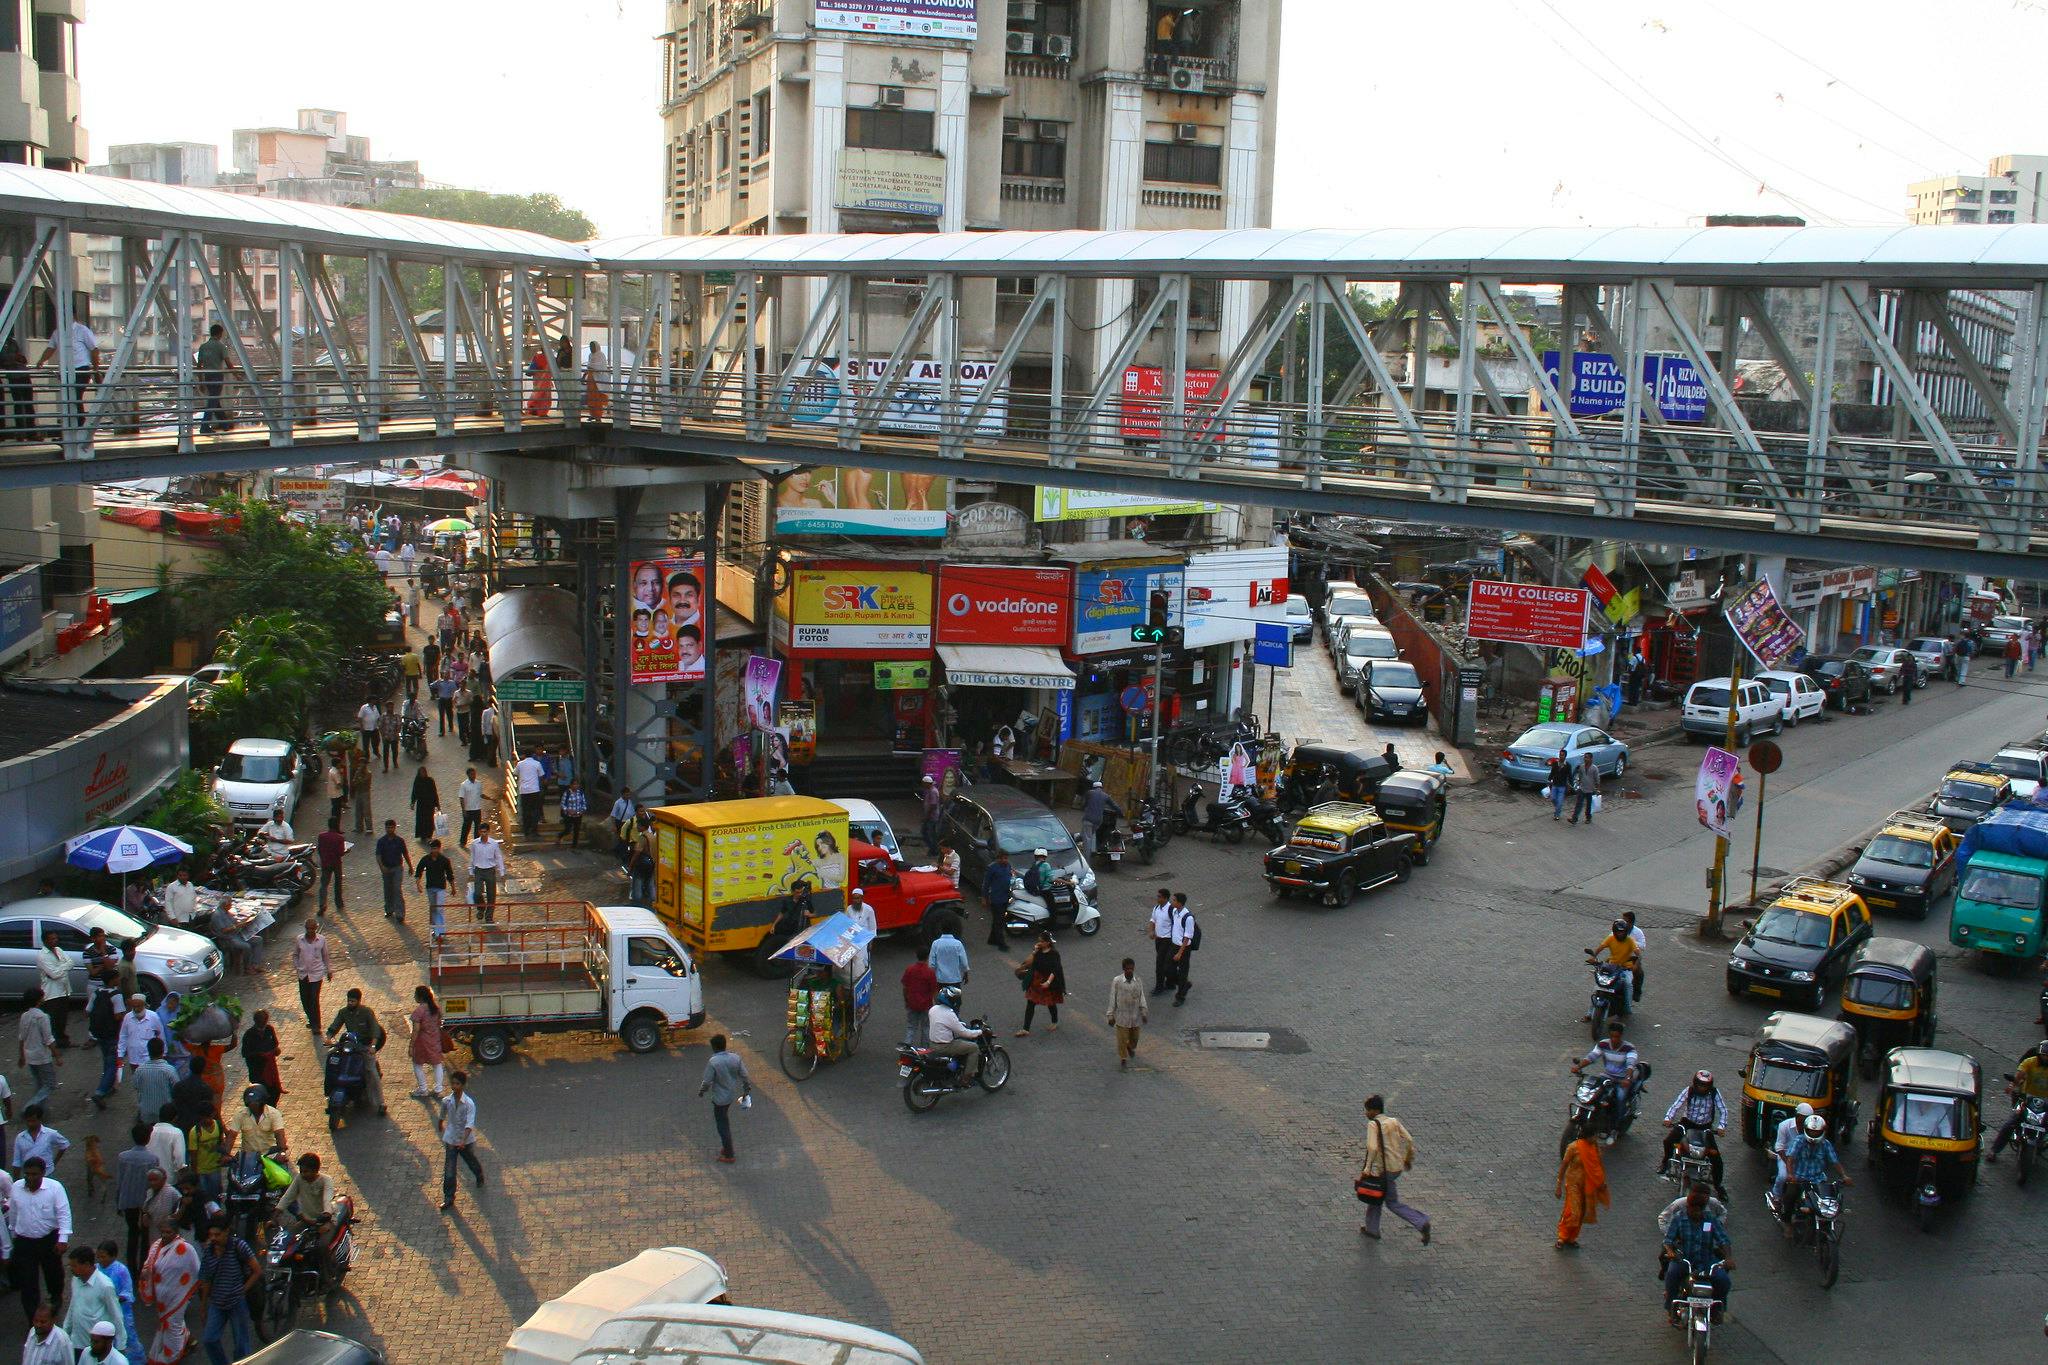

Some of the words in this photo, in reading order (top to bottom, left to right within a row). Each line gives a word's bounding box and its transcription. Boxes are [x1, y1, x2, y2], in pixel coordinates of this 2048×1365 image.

[925, 0, 974, 9] LONDON
[868, 200, 908, 210] BUSINESS
[910, 205, 940, 214] CENTER
[848, 360, 915, 377] STUY
[1582, 361, 1624, 376] RIZV
[1153, 376, 1209, 389] Kngton
[1580, 378, 1654, 396] BUILDS
[1676, 384, 1708, 400] BUILDERS
[1578, 396, 1603, 406] Name
[1604, 397, 1613, 406] in
[1151, 578, 1180, 586] NKIA
[823, 585, 880, 611] SRK
[1099, 578, 1135, 605] SRK
[1479, 584, 1513, 597] RIZVI
[1518, 588, 1579, 604] COLLEGES
[976, 597, 1058, 614] vodafone
[1120, 605, 1140, 615] store
[824, 612, 852, 620] Sandip,
[854, 612, 880, 620] Rupam
[892, 632, 905, 640] आर
[1258, 640, 1284, 649] NOKIA
[950, 673, 985, 684] QUTBI
[988, 674, 1026, 685] GLASS
[1030, 676, 1074, 688] CENTRE
[84, 752, 128, 796] Lucky
[712, 826, 756, 836] ZORABIANS
[758, 824, 774, 832] Fresh
[775, 822, 796, 830] Chilled
[798, 820, 822, 828] Chicken
[822, 817, 847, 825] Products
